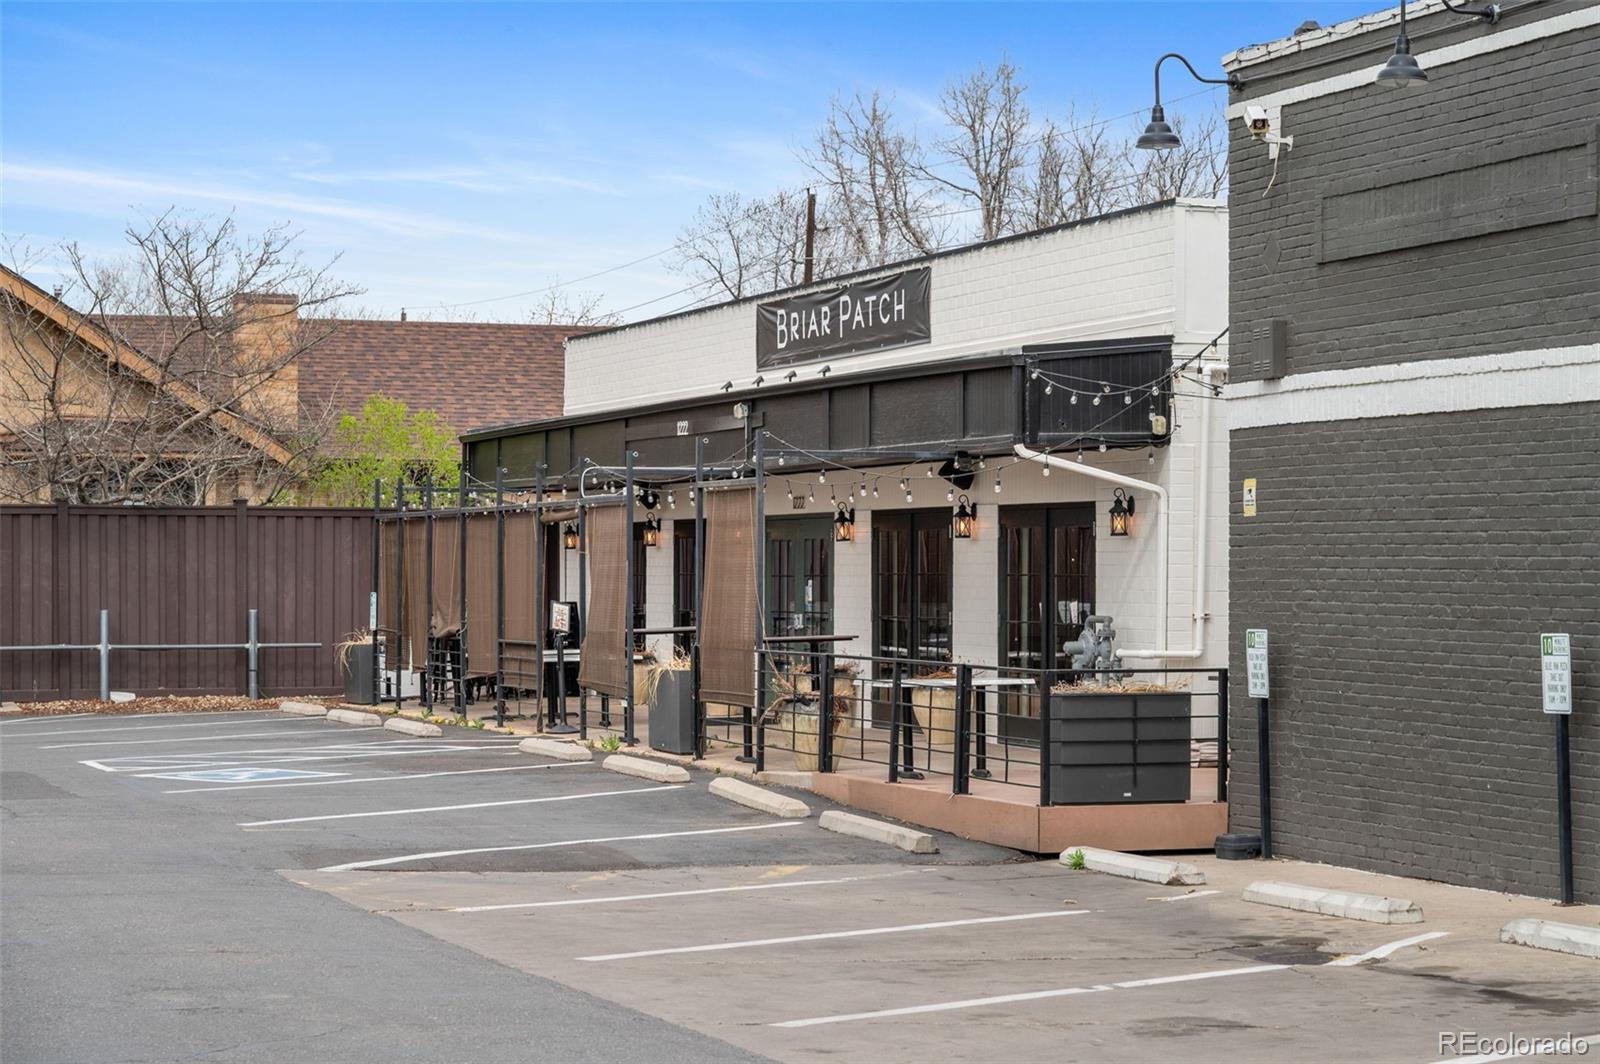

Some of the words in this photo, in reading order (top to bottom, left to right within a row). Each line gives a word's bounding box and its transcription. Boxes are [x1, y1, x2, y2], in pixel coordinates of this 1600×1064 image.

[776, 306, 831, 349] BRIAR
[839, 289, 905, 338] PATCH
[1543, 638, 1552, 654] 10
